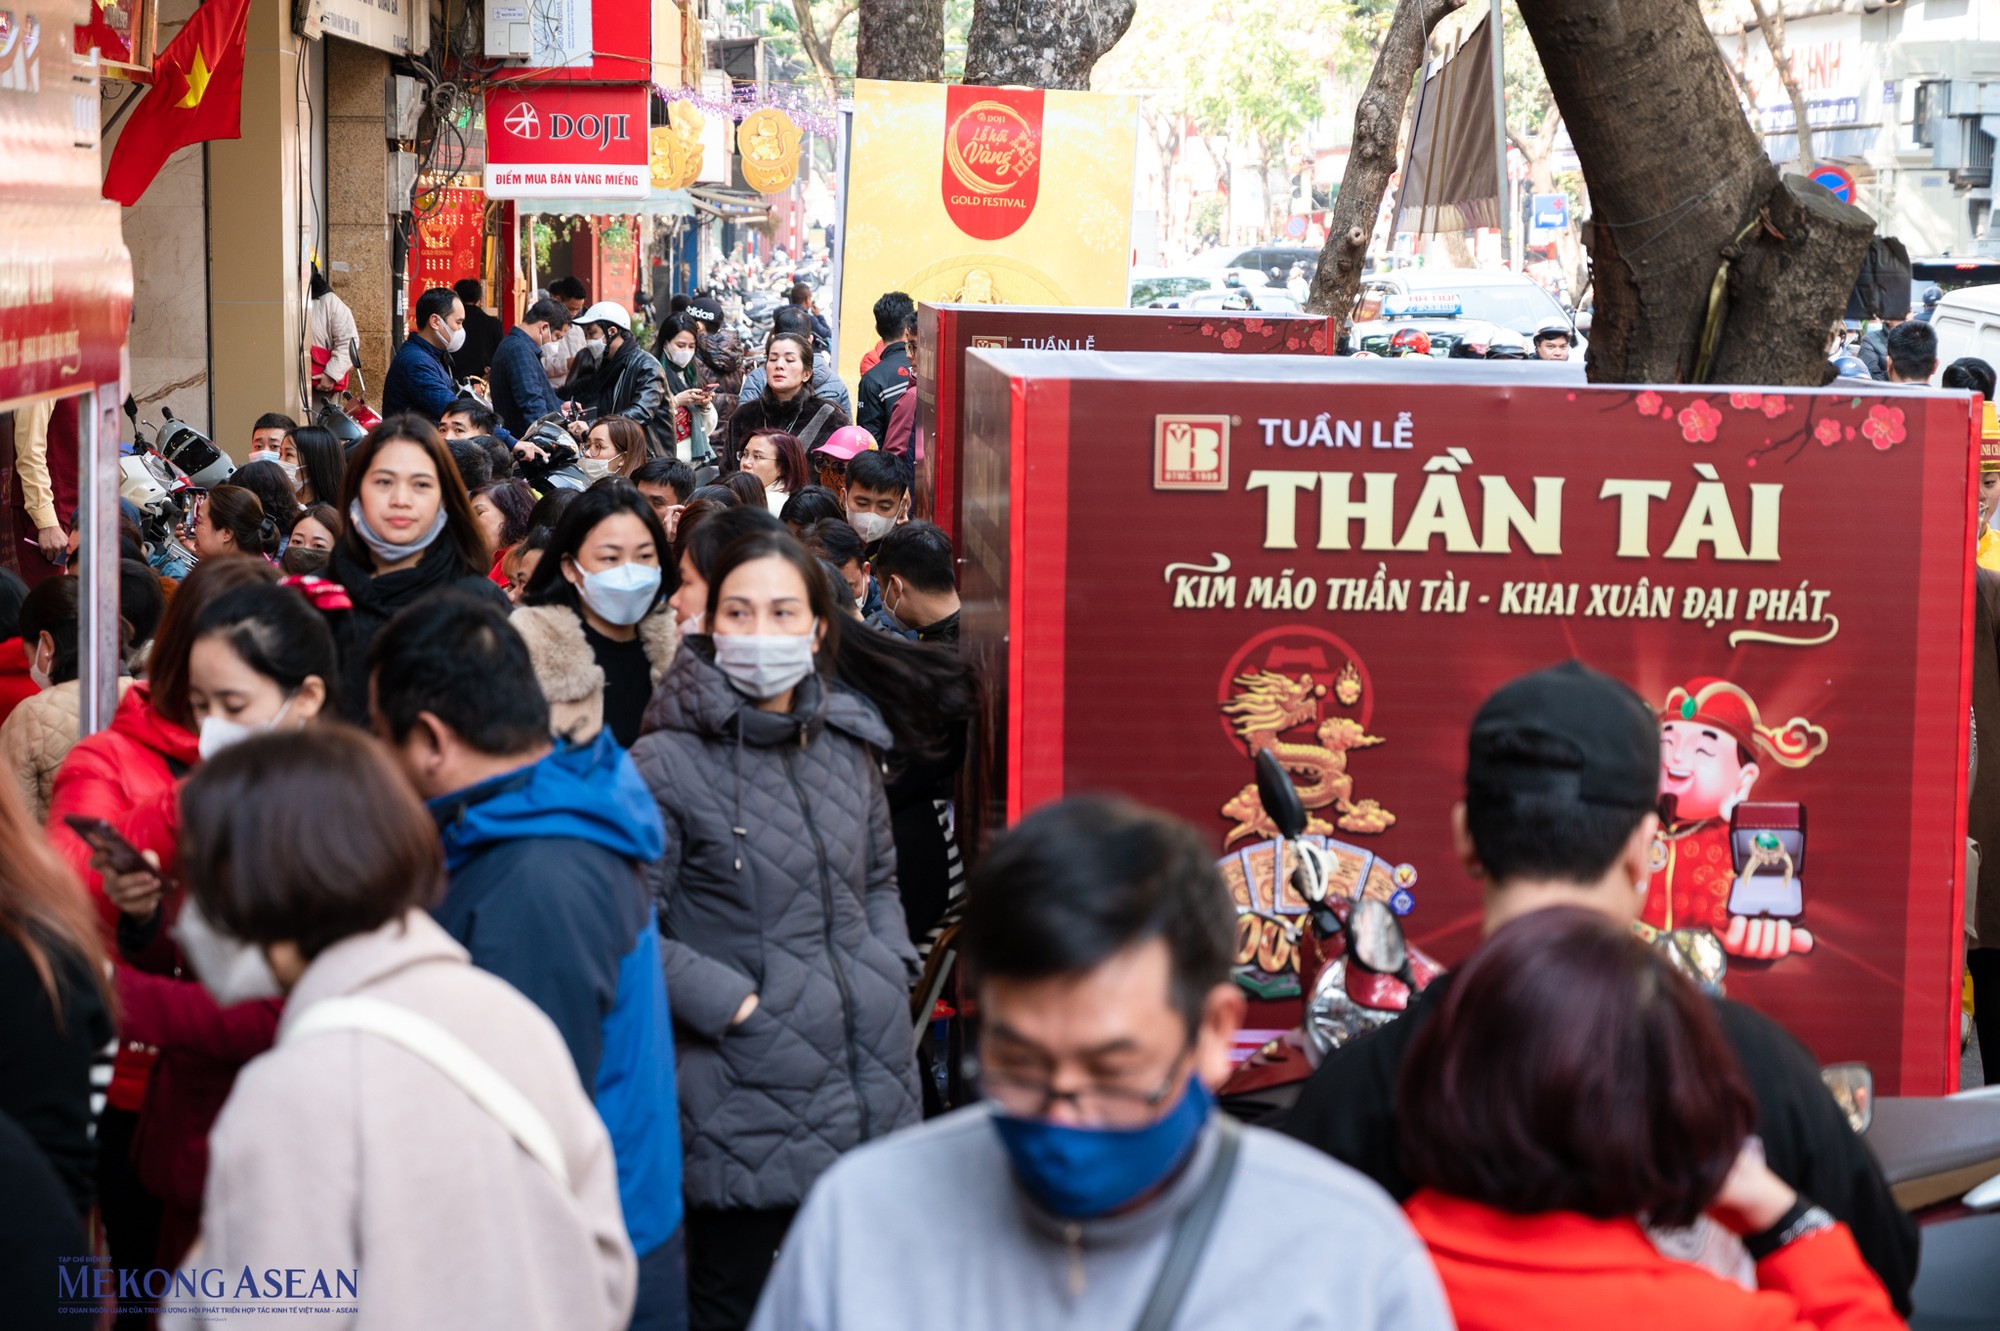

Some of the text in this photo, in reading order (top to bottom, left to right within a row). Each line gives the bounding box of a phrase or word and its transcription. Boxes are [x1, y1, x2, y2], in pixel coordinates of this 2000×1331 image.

[987, 115, 1006, 124] DOJI
[549, 113, 630, 151] DOJI
[971, 126, 1009, 146] Lễ hội
[962, 141, 1016, 176] Vàng
[496, 170, 639, 186] ĐIỂM MUA BÁN VÀNG MIẾNG
[950, 195, 1027, 208] GOLD FESTIVAL
[685, 305, 714, 320] adidas
[1020, 335, 1070, 351] TUẦN
[1257, 411, 1414, 449] TUẦN LỄ
[1245, 447, 1784, 562] THẦN TÀI
[1168, 563, 1237, 609] KIM
[1244, 568, 1317, 610] MÃO
[1325, 561, 1411, 612] THẦN
[1420, 570, 1470, 613] TÀI
[1499, 581, 1579, 616] KHAI
[1584, 576, 1675, 618] XUÂN
[1682, 586, 1738, 628] ĐẠI
[1743, 580, 1837, 630] PHÁT
